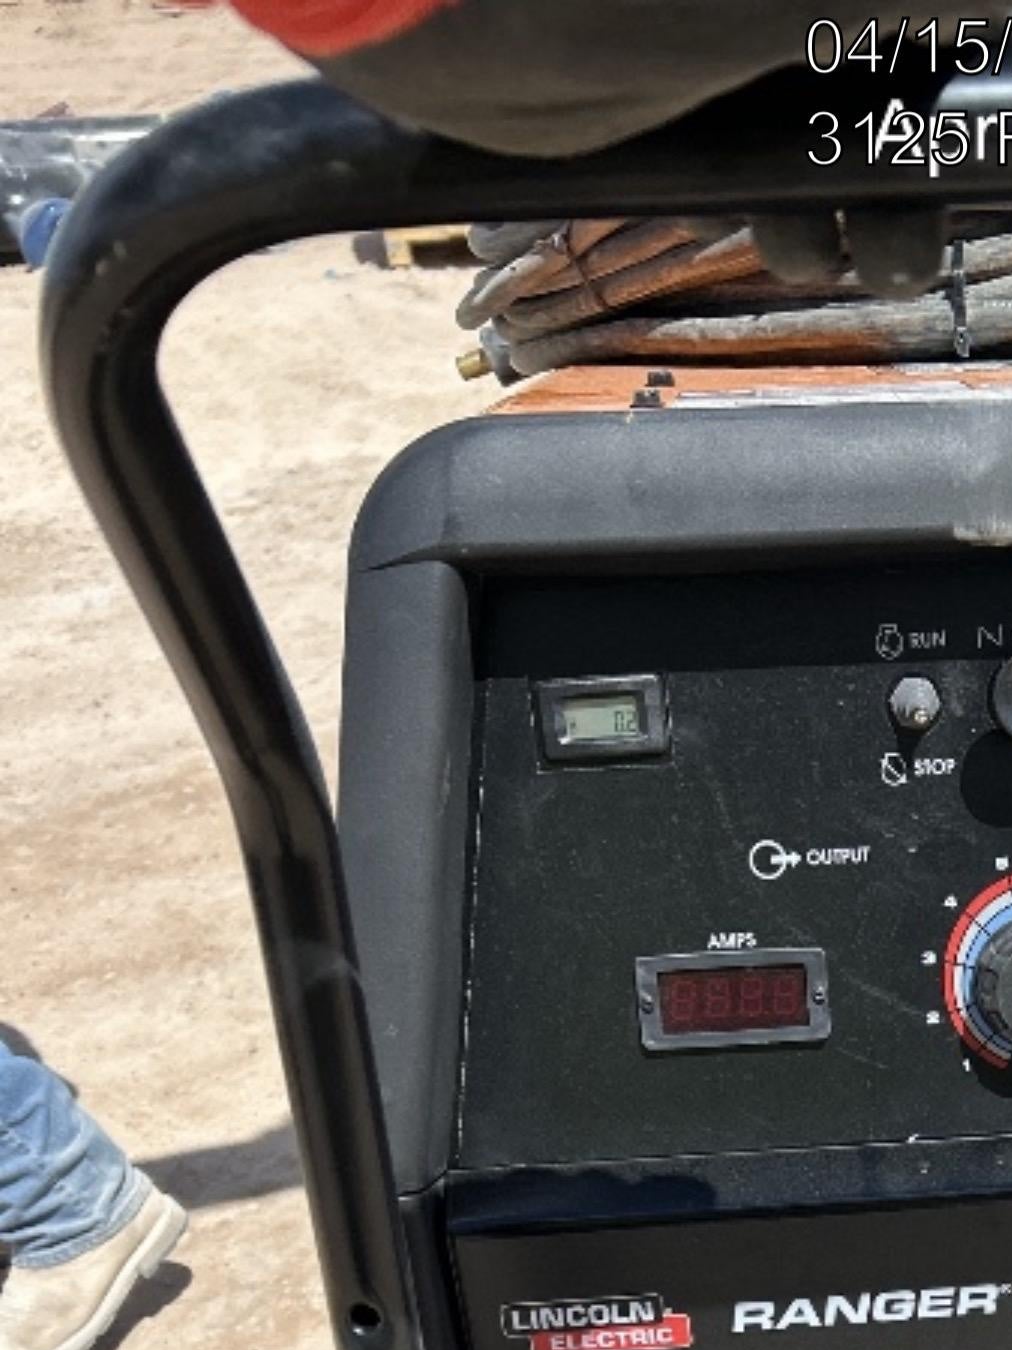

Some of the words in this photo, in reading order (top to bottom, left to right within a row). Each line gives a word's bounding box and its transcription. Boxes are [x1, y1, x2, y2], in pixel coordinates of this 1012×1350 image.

[908, 630, 946, 648] RUN
[913, 757, 955, 775] STOP
[805, 845, 870, 865] OUTPUT
[943, 894, 958, 908] 4
[706, 931, 757, 949] AMPS
[511, 1300, 656, 1331] LINCOLN
